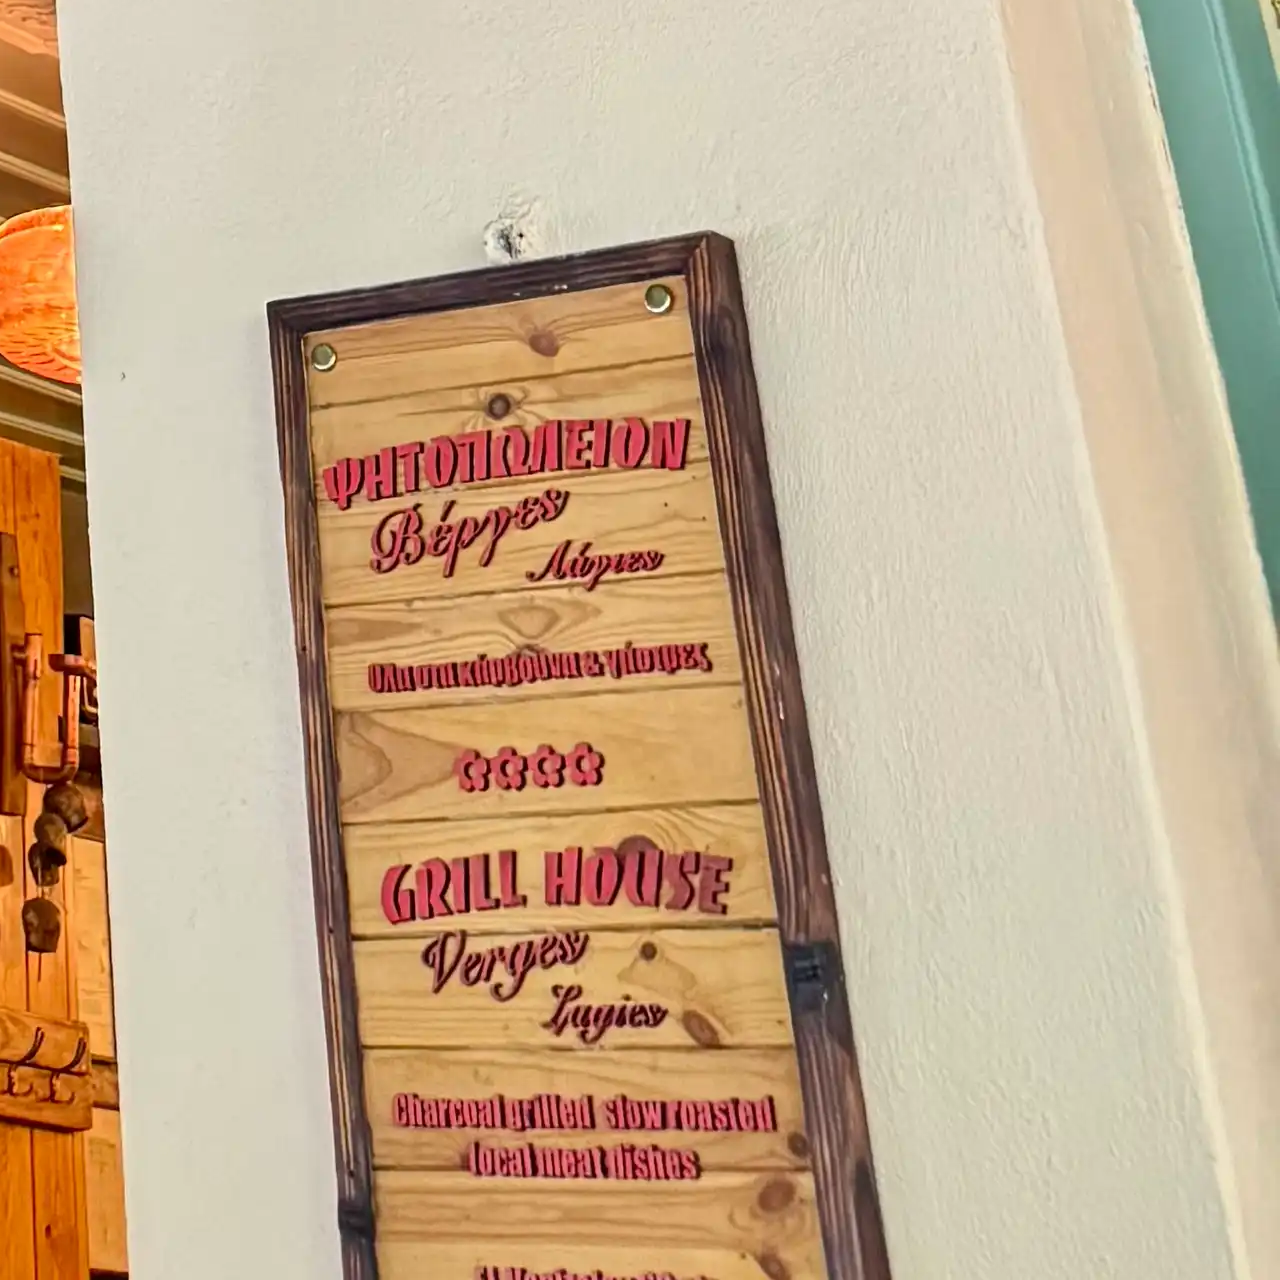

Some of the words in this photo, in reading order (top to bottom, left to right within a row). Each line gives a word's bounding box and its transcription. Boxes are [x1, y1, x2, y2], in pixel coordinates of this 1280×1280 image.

[322, 417, 691, 510] ΨΗΤΟΠΩΛΕΙΟΝ
[370, 486, 570, 578] Βέργες
[583, 650, 605, 677] &
[381, 849, 527, 925] GRILL
[544, 846, 734, 915] HOUSE
[421, 929, 590, 1002] Verges
[541, 984, 669, 1044] Lugies
[393, 1093, 506, 1129] Charcoal
[506, 1094, 596, 1132] grilled
[603, 1094, 666, 1130] slow
[666, 1095, 778, 1133] roasted
[468, 1141, 539, 1178] local
[539, 1145, 606, 1179] meat
[606, 1143, 701, 1180] dishes
